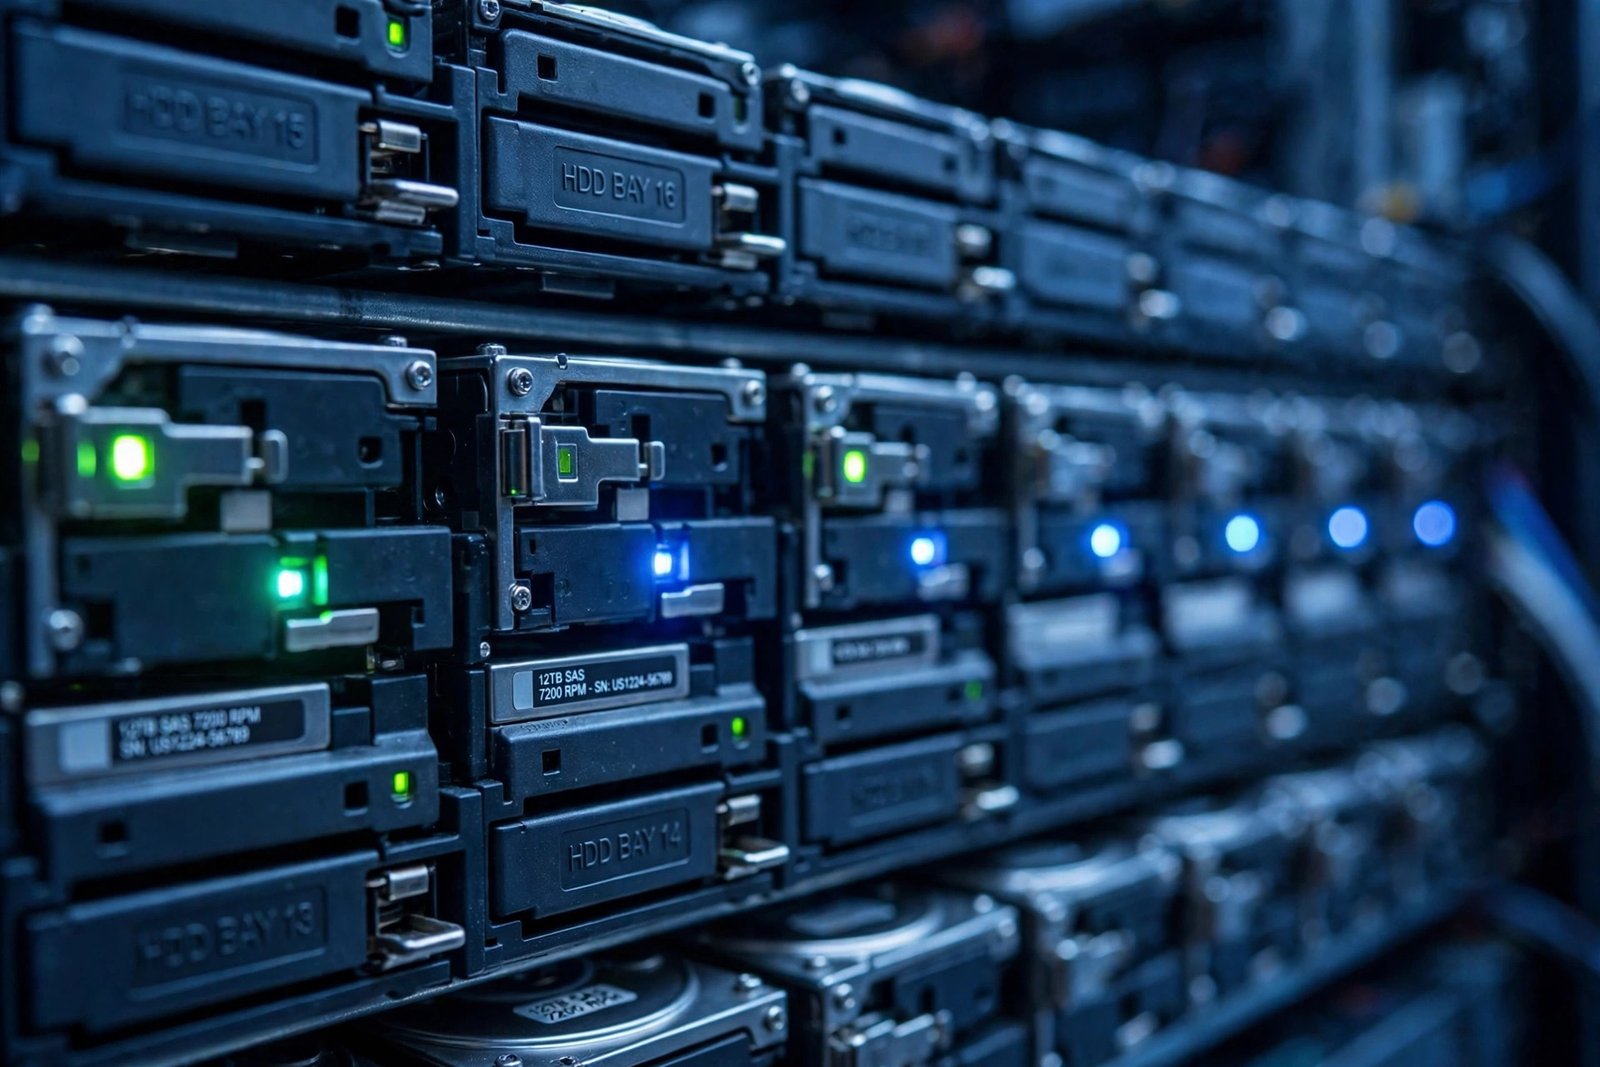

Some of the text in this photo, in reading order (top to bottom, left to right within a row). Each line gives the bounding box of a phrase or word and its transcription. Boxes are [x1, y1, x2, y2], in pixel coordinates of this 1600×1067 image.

[562, 163, 676, 209] HDD BAY 16
[538, 669, 585, 686] 12TB SAS
[539, 687, 562, 701] 7200
[564, 683, 586, 698] RPM
[594, 680, 611, 693] SN:
[568, 821, 681, 872] HDD BAY 14
